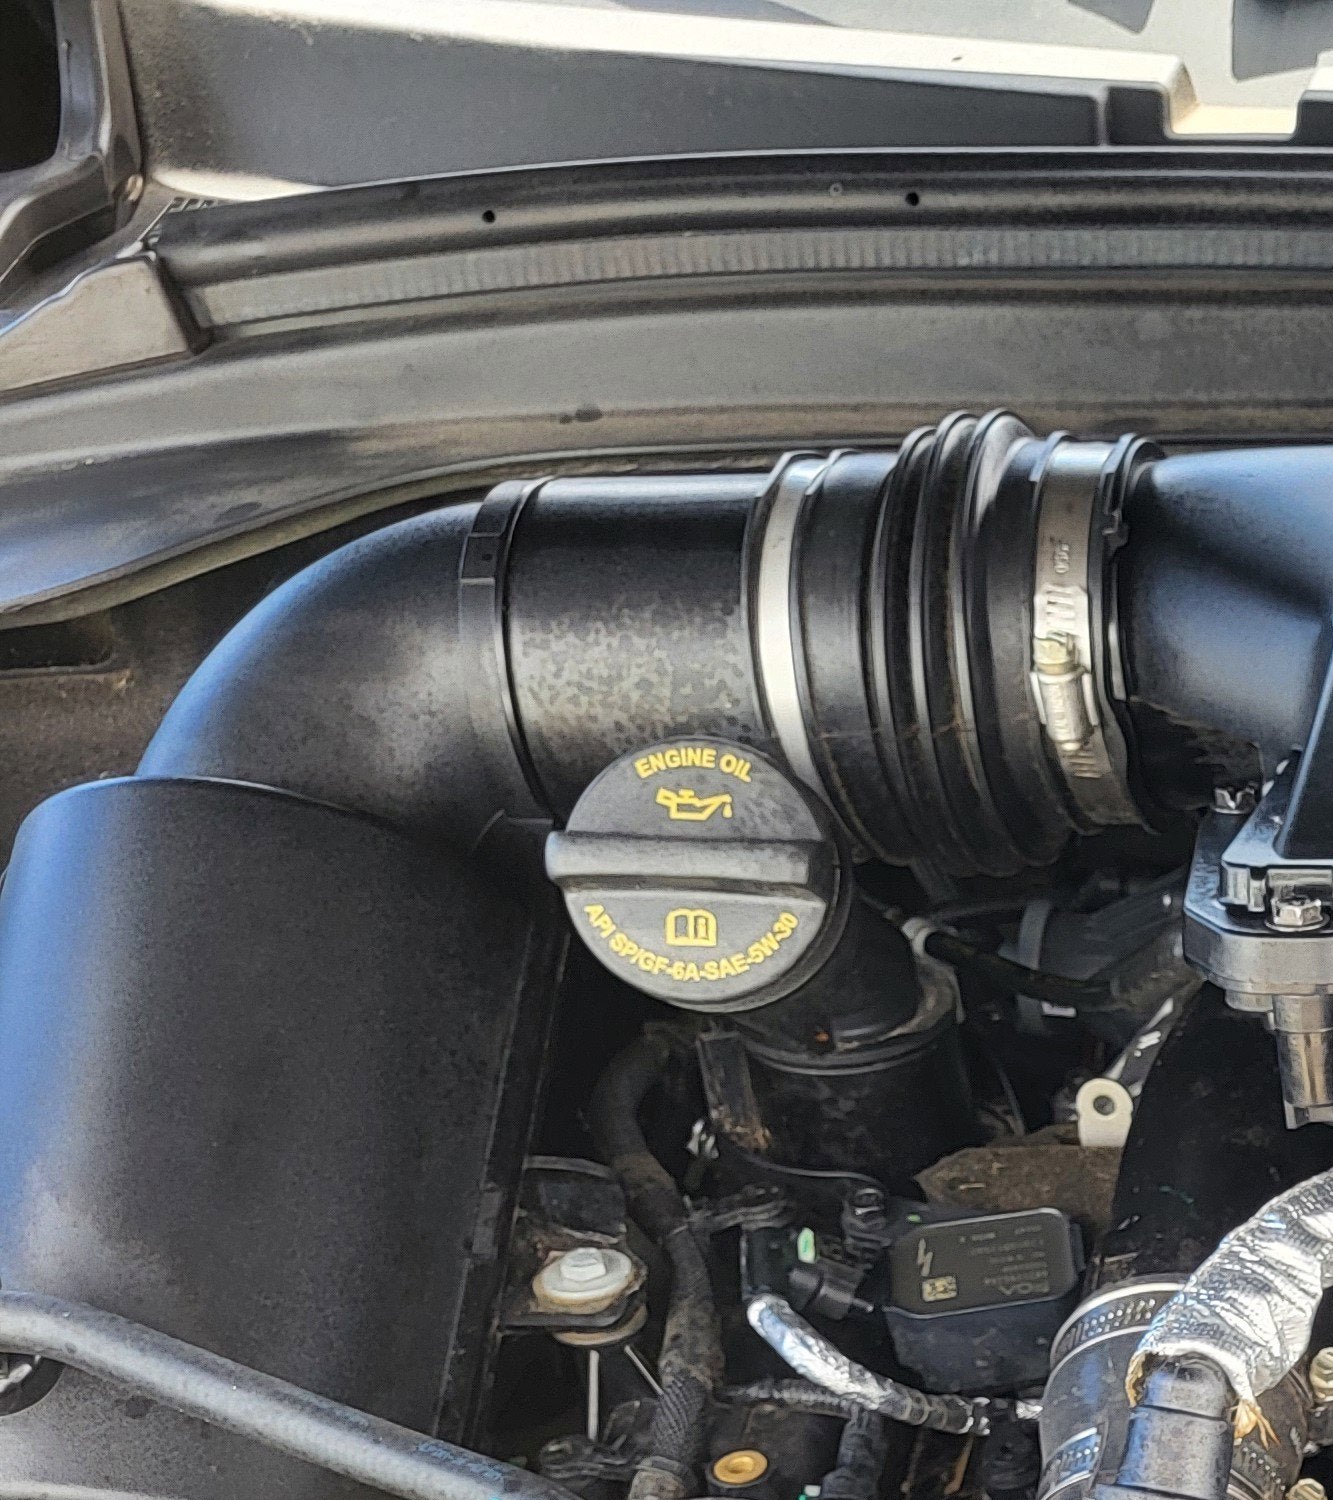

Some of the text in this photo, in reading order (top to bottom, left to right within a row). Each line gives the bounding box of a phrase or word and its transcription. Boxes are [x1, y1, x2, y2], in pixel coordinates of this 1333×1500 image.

[633, 747, 753, 783] ENGINE OIL
[585, 903, 616, 939] API
